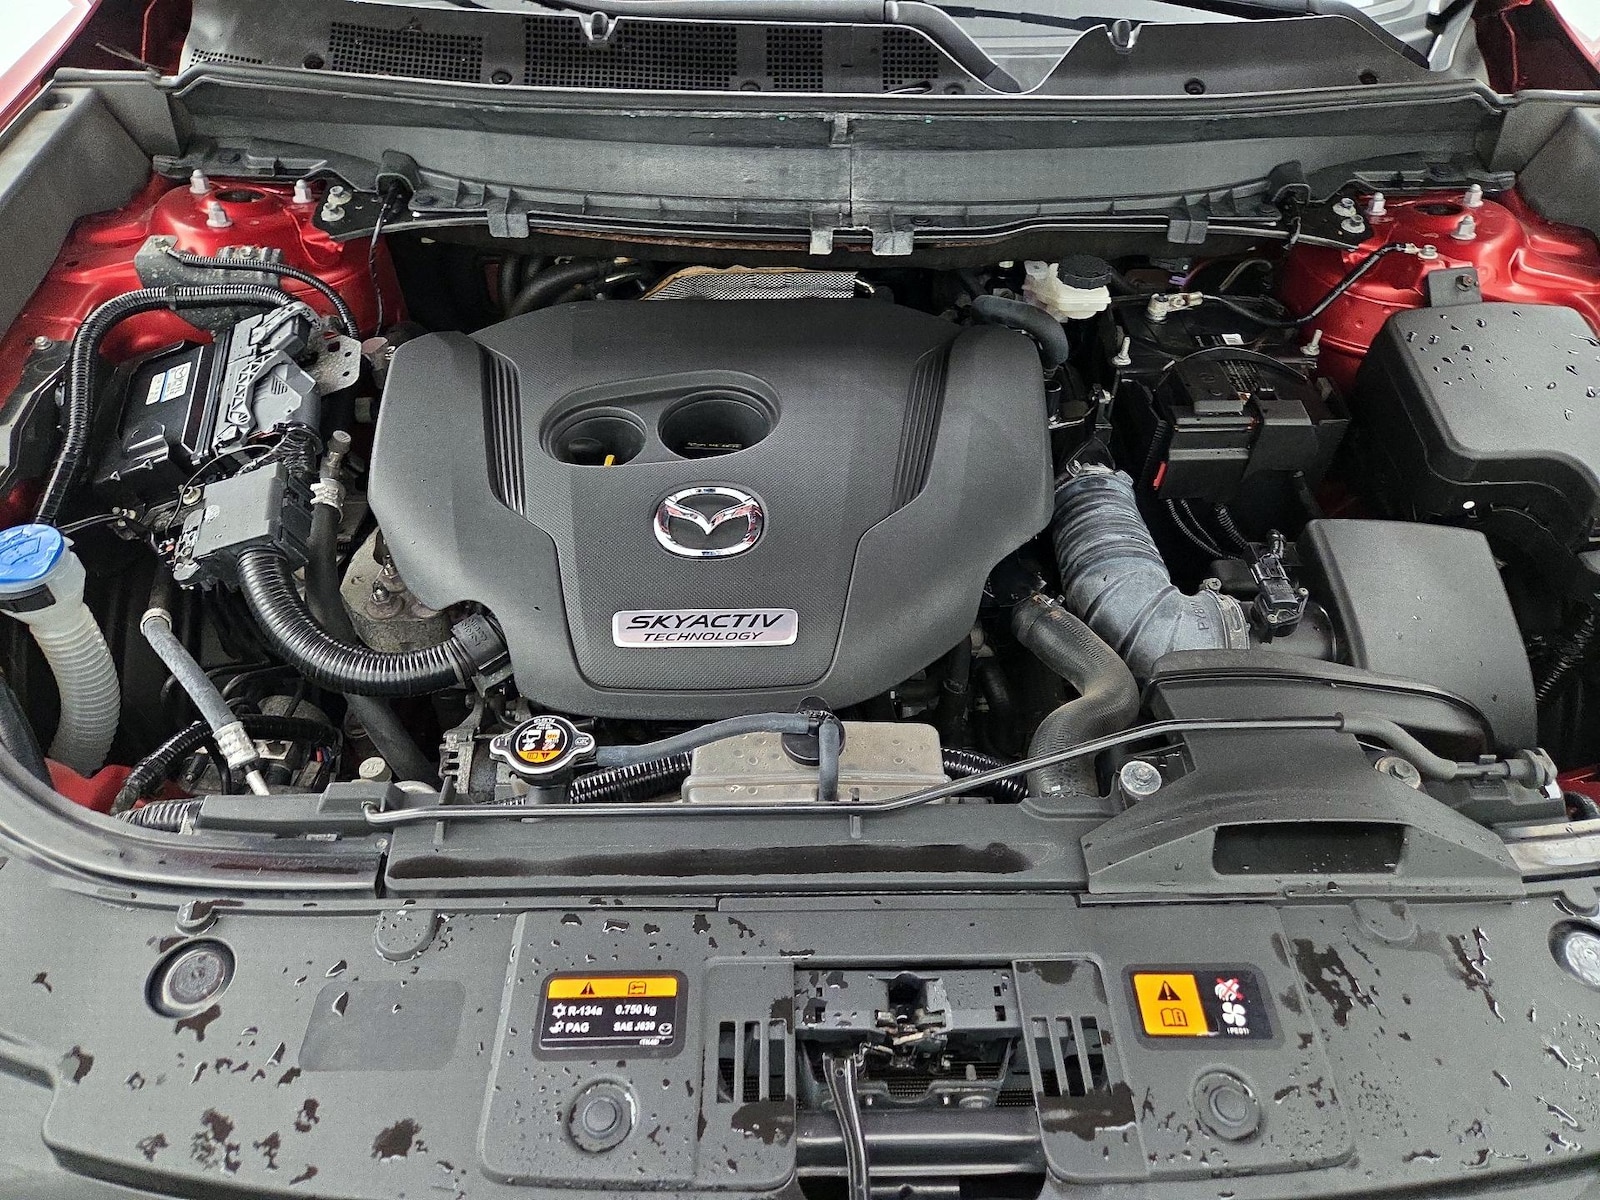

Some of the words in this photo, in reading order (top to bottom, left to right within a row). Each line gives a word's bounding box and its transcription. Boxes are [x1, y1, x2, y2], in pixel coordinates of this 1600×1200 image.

[626, 613, 785, 630] SKYACTIV
[643, 631, 764, 642] TECHNOLOGY
[567, 1005, 603, 1017] R-134a
[615, 1004, 643, 1015] 0.750
[643, 1004, 657, 1017] kg
[565, 1022, 590, 1033] PAG
[613, 1021, 634, 1032] SAE
